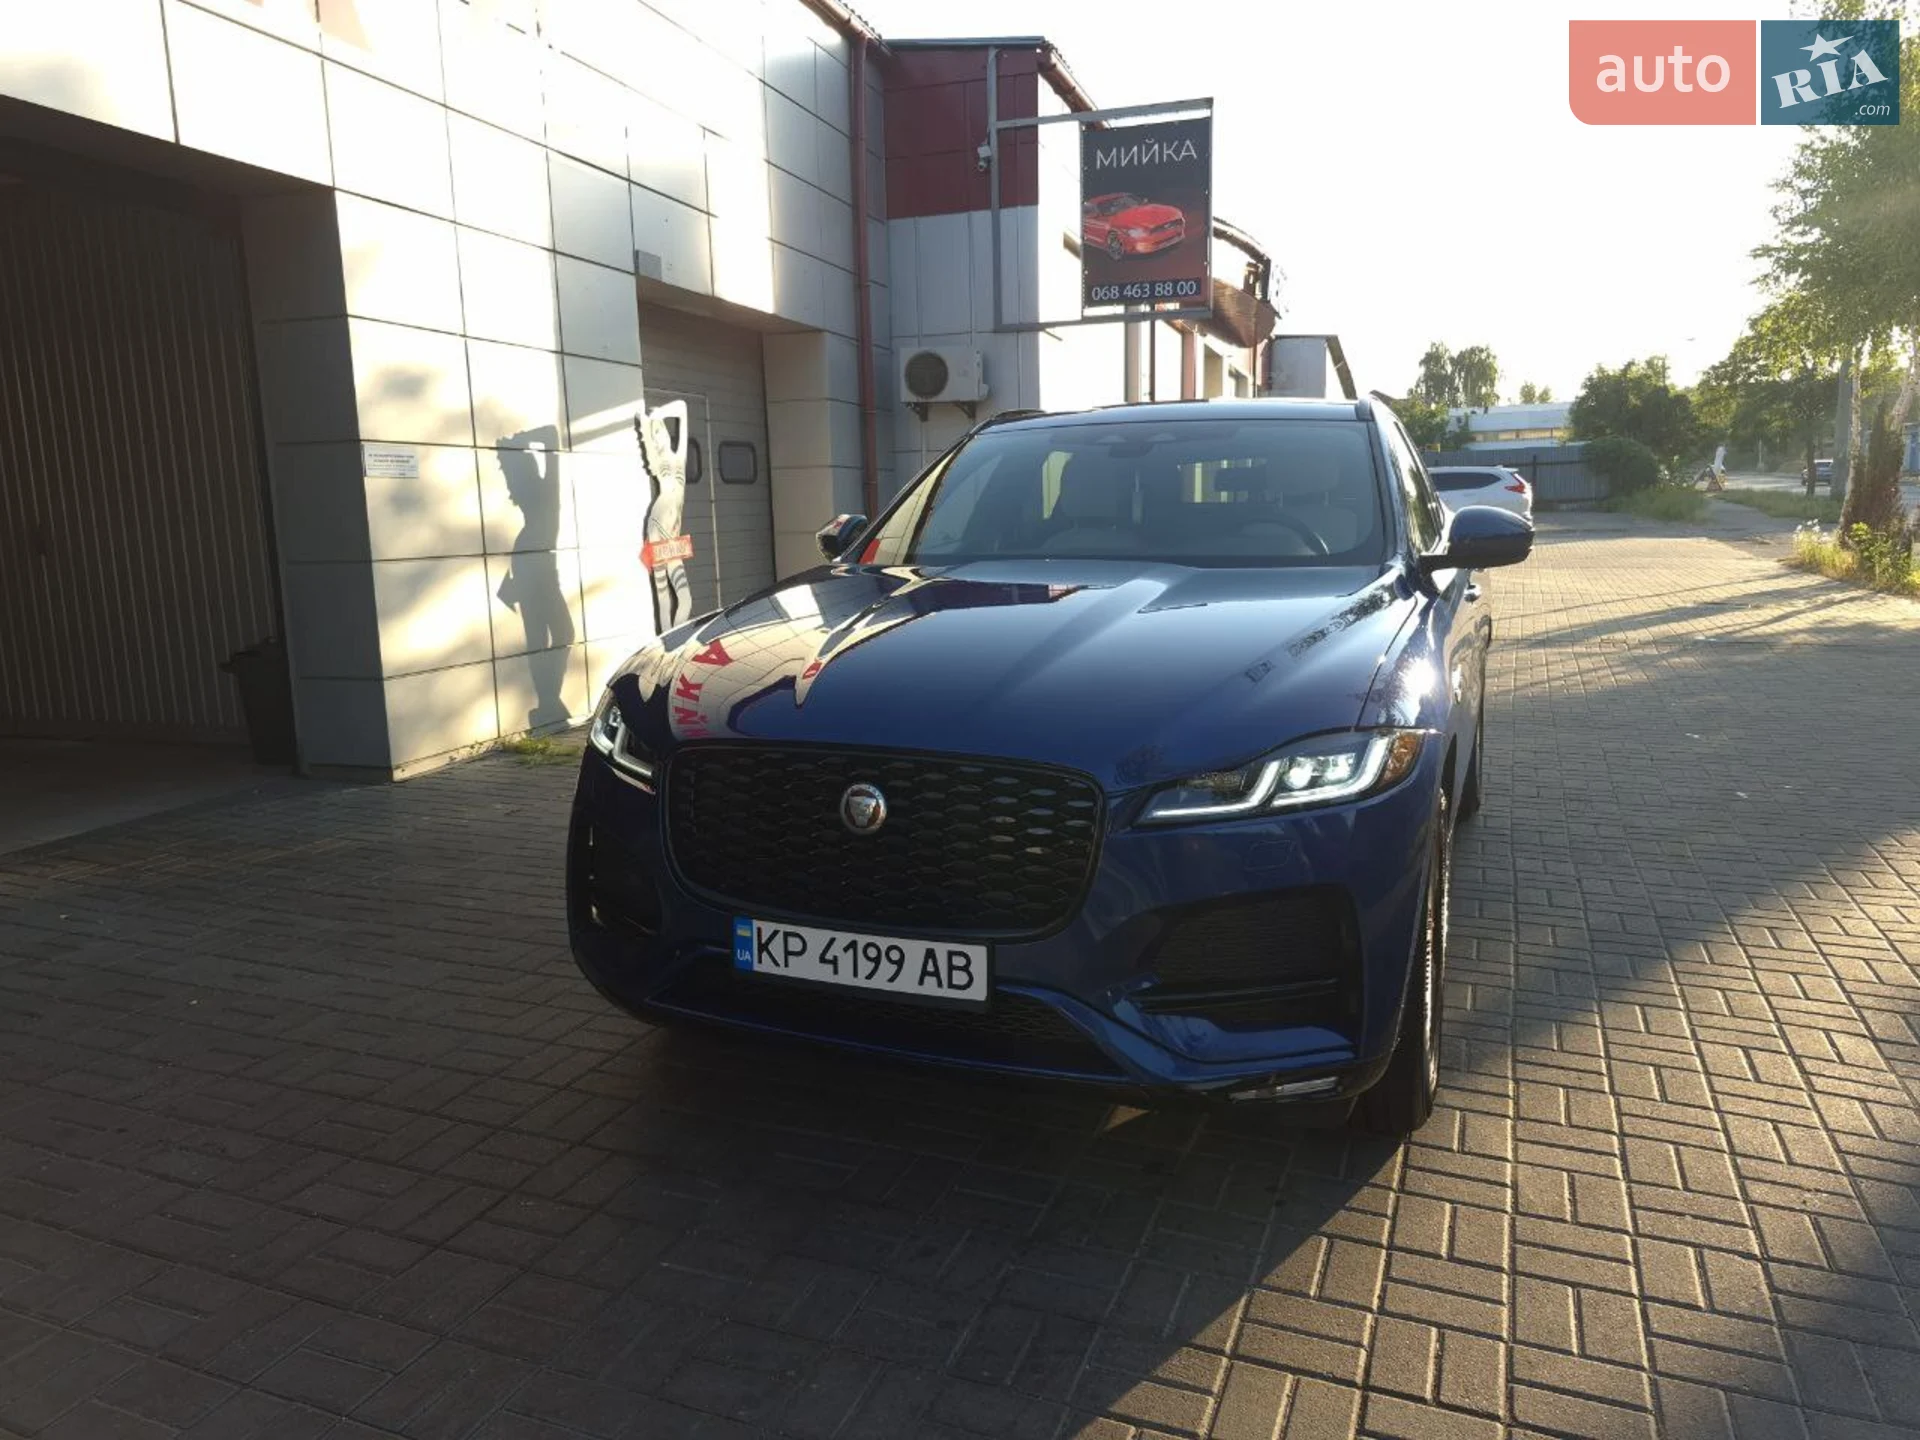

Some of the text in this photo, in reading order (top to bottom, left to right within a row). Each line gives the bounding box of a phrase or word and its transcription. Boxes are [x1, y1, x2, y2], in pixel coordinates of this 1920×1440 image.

[1095, 138, 1197, 169] МИЙКА
[1091, 280, 1197, 301] 068 463 88 00
[737, 949, 751, 961] UA
[756, 926, 974, 991] KP 4199 AB
